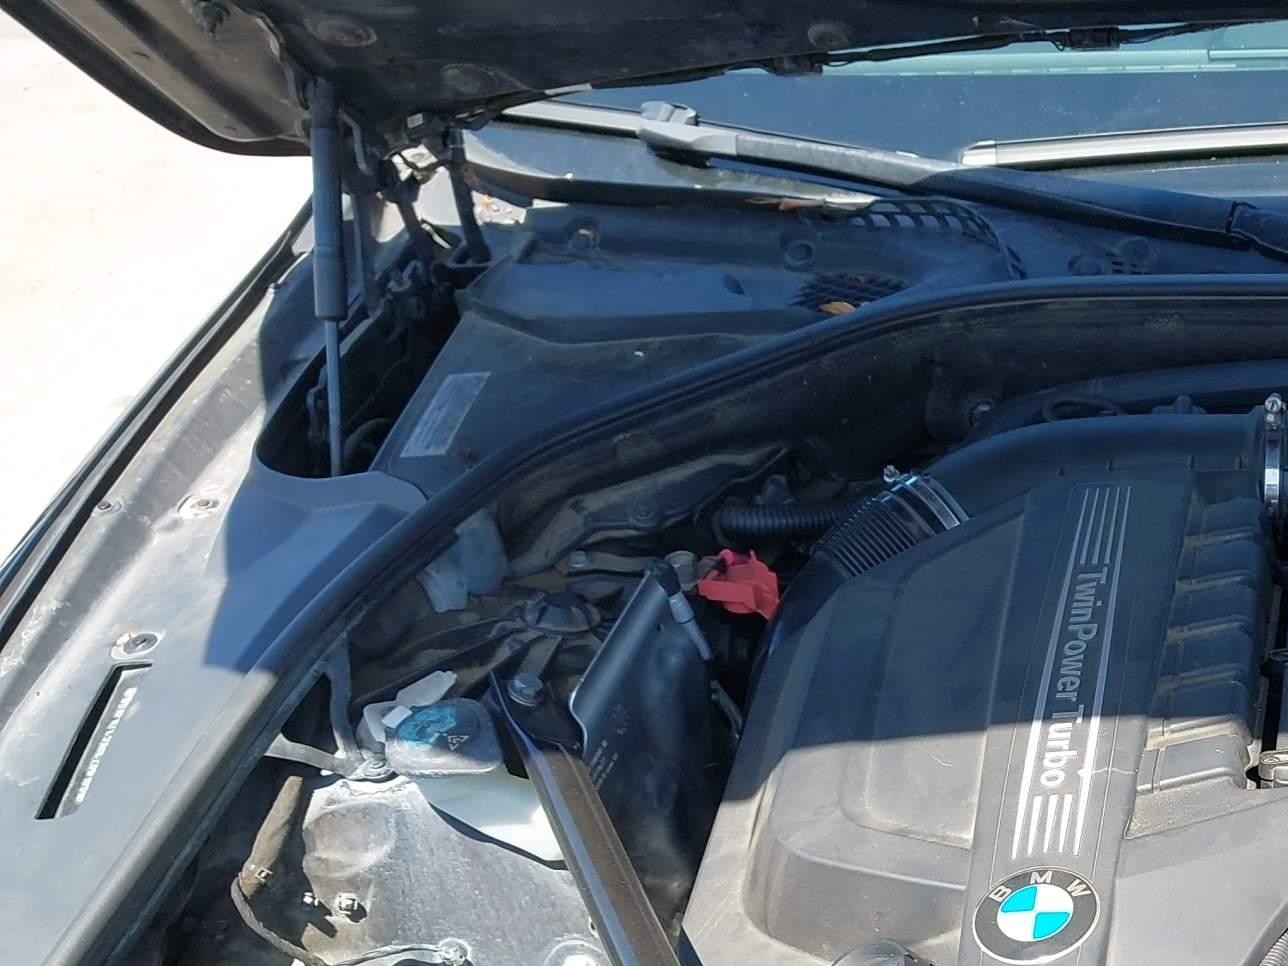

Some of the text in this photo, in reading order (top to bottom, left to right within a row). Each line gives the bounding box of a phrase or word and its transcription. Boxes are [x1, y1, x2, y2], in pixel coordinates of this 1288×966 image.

[1040, 566, 1108, 787] TwinPower Turbo
[988, 870, 1092, 903] BMW
